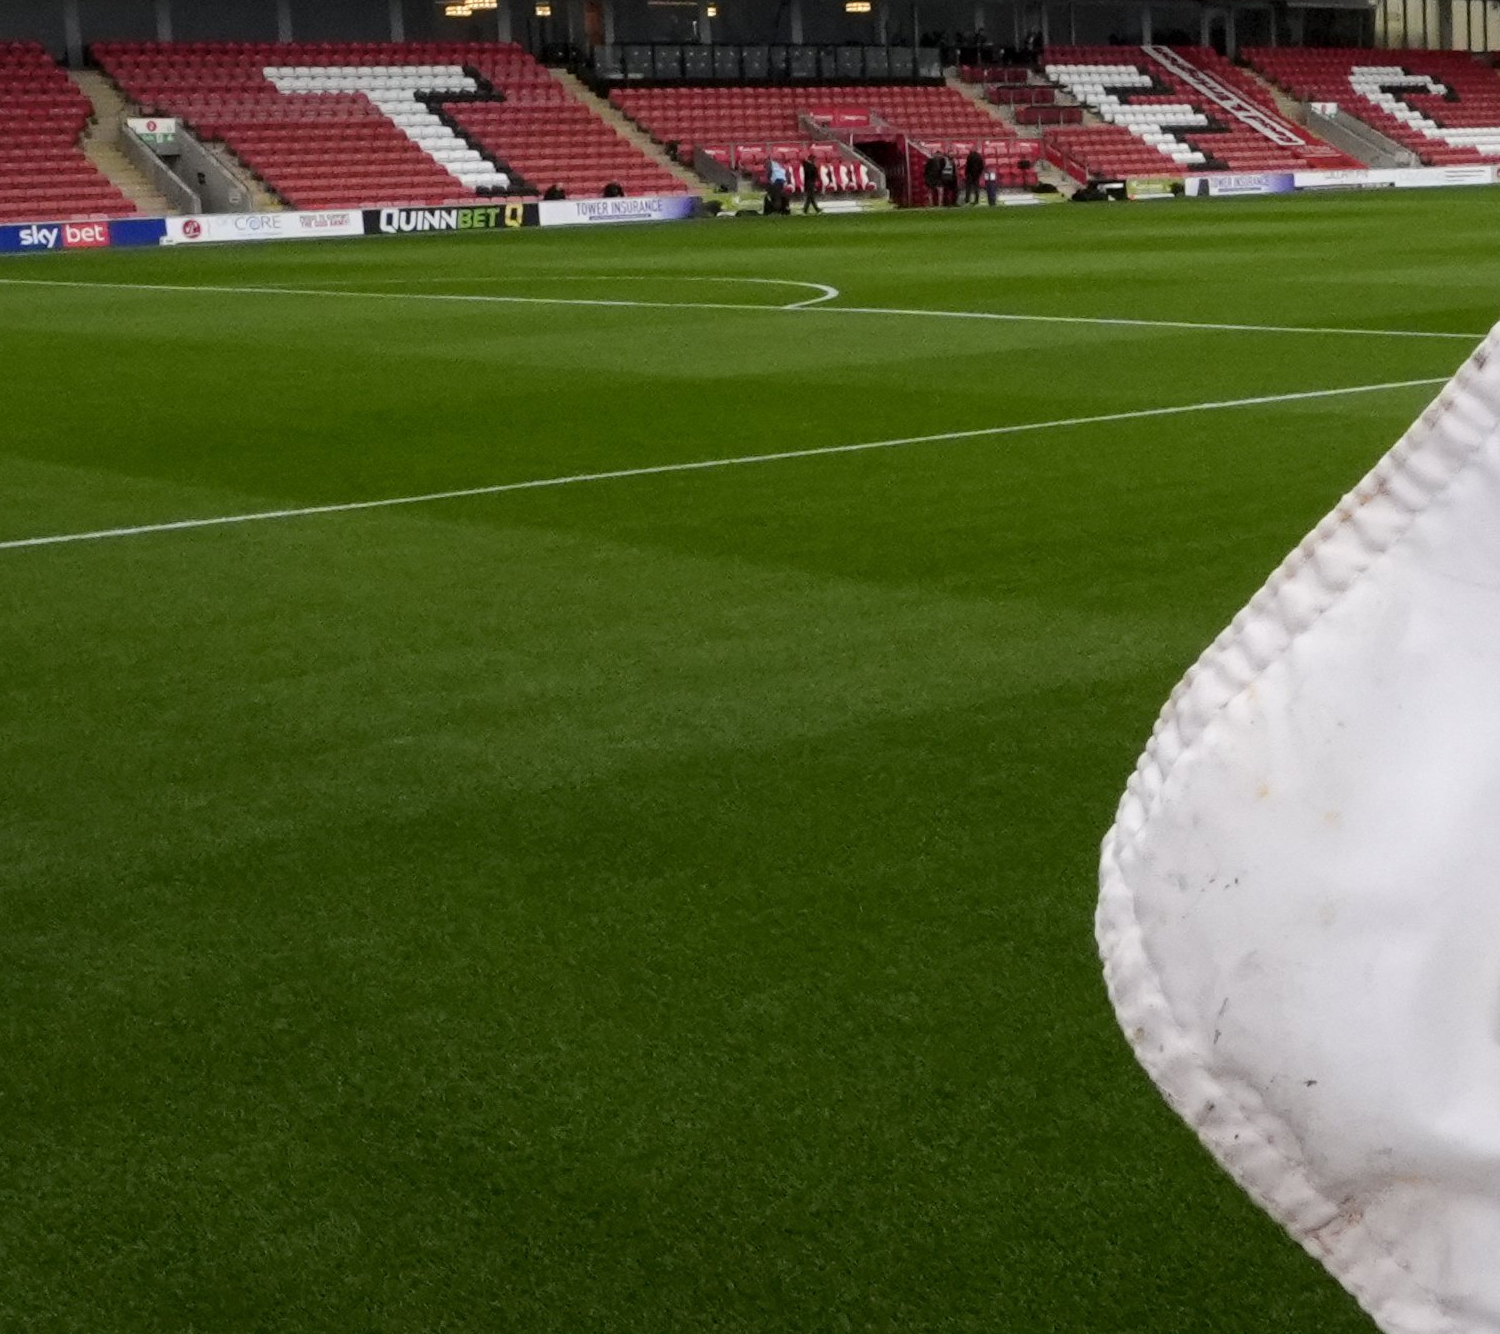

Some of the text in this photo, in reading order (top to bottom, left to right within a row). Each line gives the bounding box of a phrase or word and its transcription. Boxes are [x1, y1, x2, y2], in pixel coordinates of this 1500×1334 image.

[575, 199, 663, 216] TOWER INSURANCE
[234, 215, 282, 231] CORE
[379, 207, 500, 234] QUINNBET
[18, 224, 105, 249] sky bet
